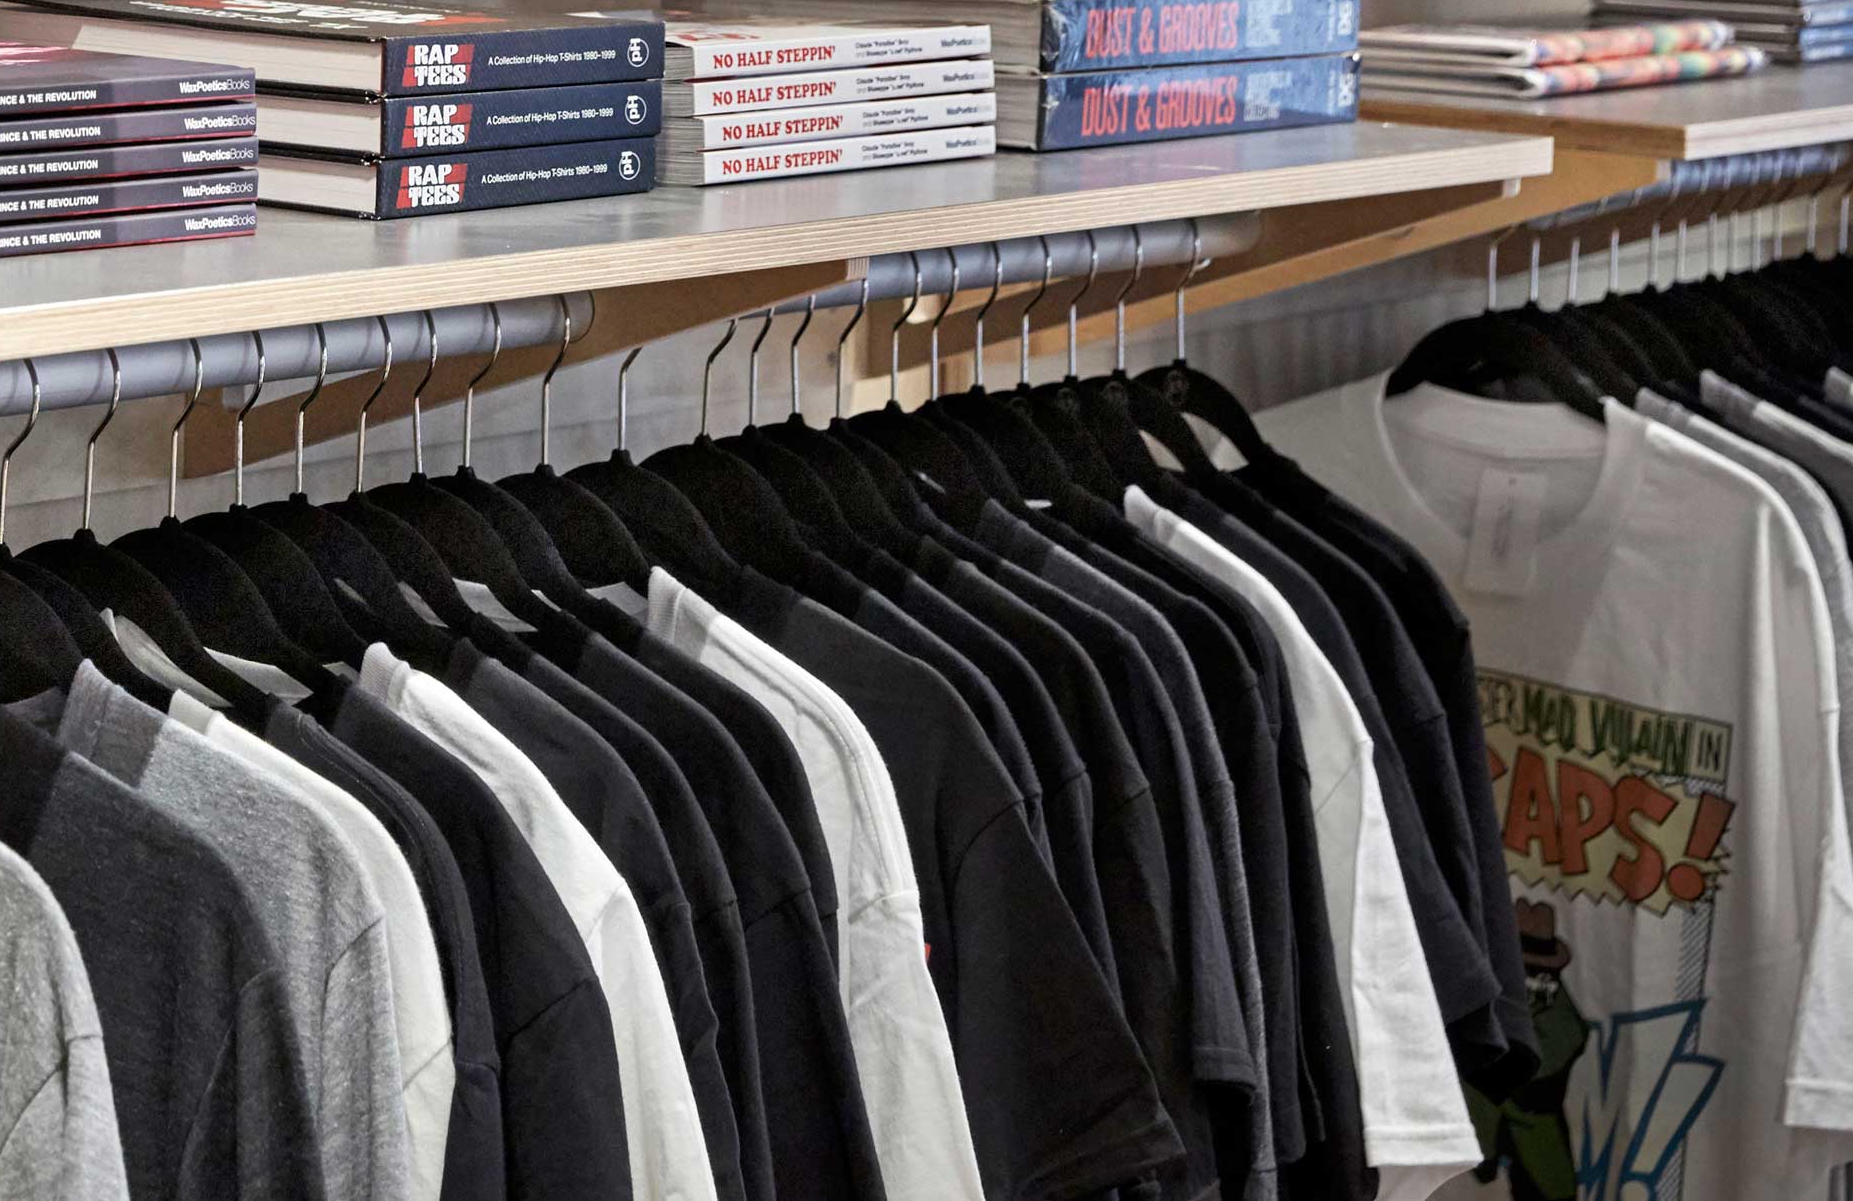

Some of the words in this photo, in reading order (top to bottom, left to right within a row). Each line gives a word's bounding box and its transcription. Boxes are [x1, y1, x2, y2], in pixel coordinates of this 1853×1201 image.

[1086, 7, 1137, 59] DUST
[1139, 6, 1155, 53] &
[1158, 1, 1239, 53] GROOVES
[415, 44, 458, 65] RAP
[488, 57, 493, 66] A
[494, 56, 525, 65] Collection
[525, 55, 532, 63] of
[533, 54, 558, 64] Hip-Hop
[559, 52, 582, 61] T-Shirts
[713, 54, 733, 69] NO
[737, 50, 773, 67] HALF
[777, 46, 835, 63] STEPPIN'
[415, 64, 467, 86] TEES
[19, 95, 25, 104] &
[27, 94, 44, 103] THE
[45, 90, 97, 102] REVOLUTION
[713, 91, 732, 107] NO
[737, 87, 773, 104] HALF
[777, 82, 836, 100] STEPPIN'
[413, 104, 457, 125] RAP
[1081, 85, 1133, 137] DUST
[1135, 83, 1152, 132] &
[1155, 75, 1238, 130] GROOVES
[487, 117, 492, 125] A
[492, 114, 523, 124] Collection
[524, 114, 531, 122] of
[532, 113, 556, 123] Hip-Hop
[557, 111, 580, 120] T-Shirts
[723, 126, 742, 141] NO
[746, 122, 781, 138] HALF
[785, 116, 843, 134] STEPPIN'
[22, 131, 28, 141] &
[30, 130, 47, 140] THE
[49, 126, 100, 138] REVOLUTION
[414, 125, 465, 147] TEES
[20, 164, 26, 174] &
[28, 163, 45, 173] THE
[47, 160, 98, 172] REVOLUTION
[723, 159, 742, 174] NO
[746, 155, 781, 172] HALF
[785, 150, 842, 168] STEPPIN'
[408, 164, 452, 185] RAP
[482, 175, 487, 184] A
[487, 173, 518, 183] Collection
[518, 172, 525, 180] of
[526, 170, 551, 181] Hip-Hop
[551, 168, 574, 177] T-Shirts
[21, 201, 27, 211] &
[29, 200, 45, 210] THE
[47, 195, 98, 208] REVOLUTION
[408, 184, 460, 207] TEES
[23, 236, 29, 246] &
[31, 235, 47, 245] THE
[49, 230, 101, 243] REVOLUTION
[1697, 729, 1724, 772] IN
[1486, 744, 1736, 903] APS!
